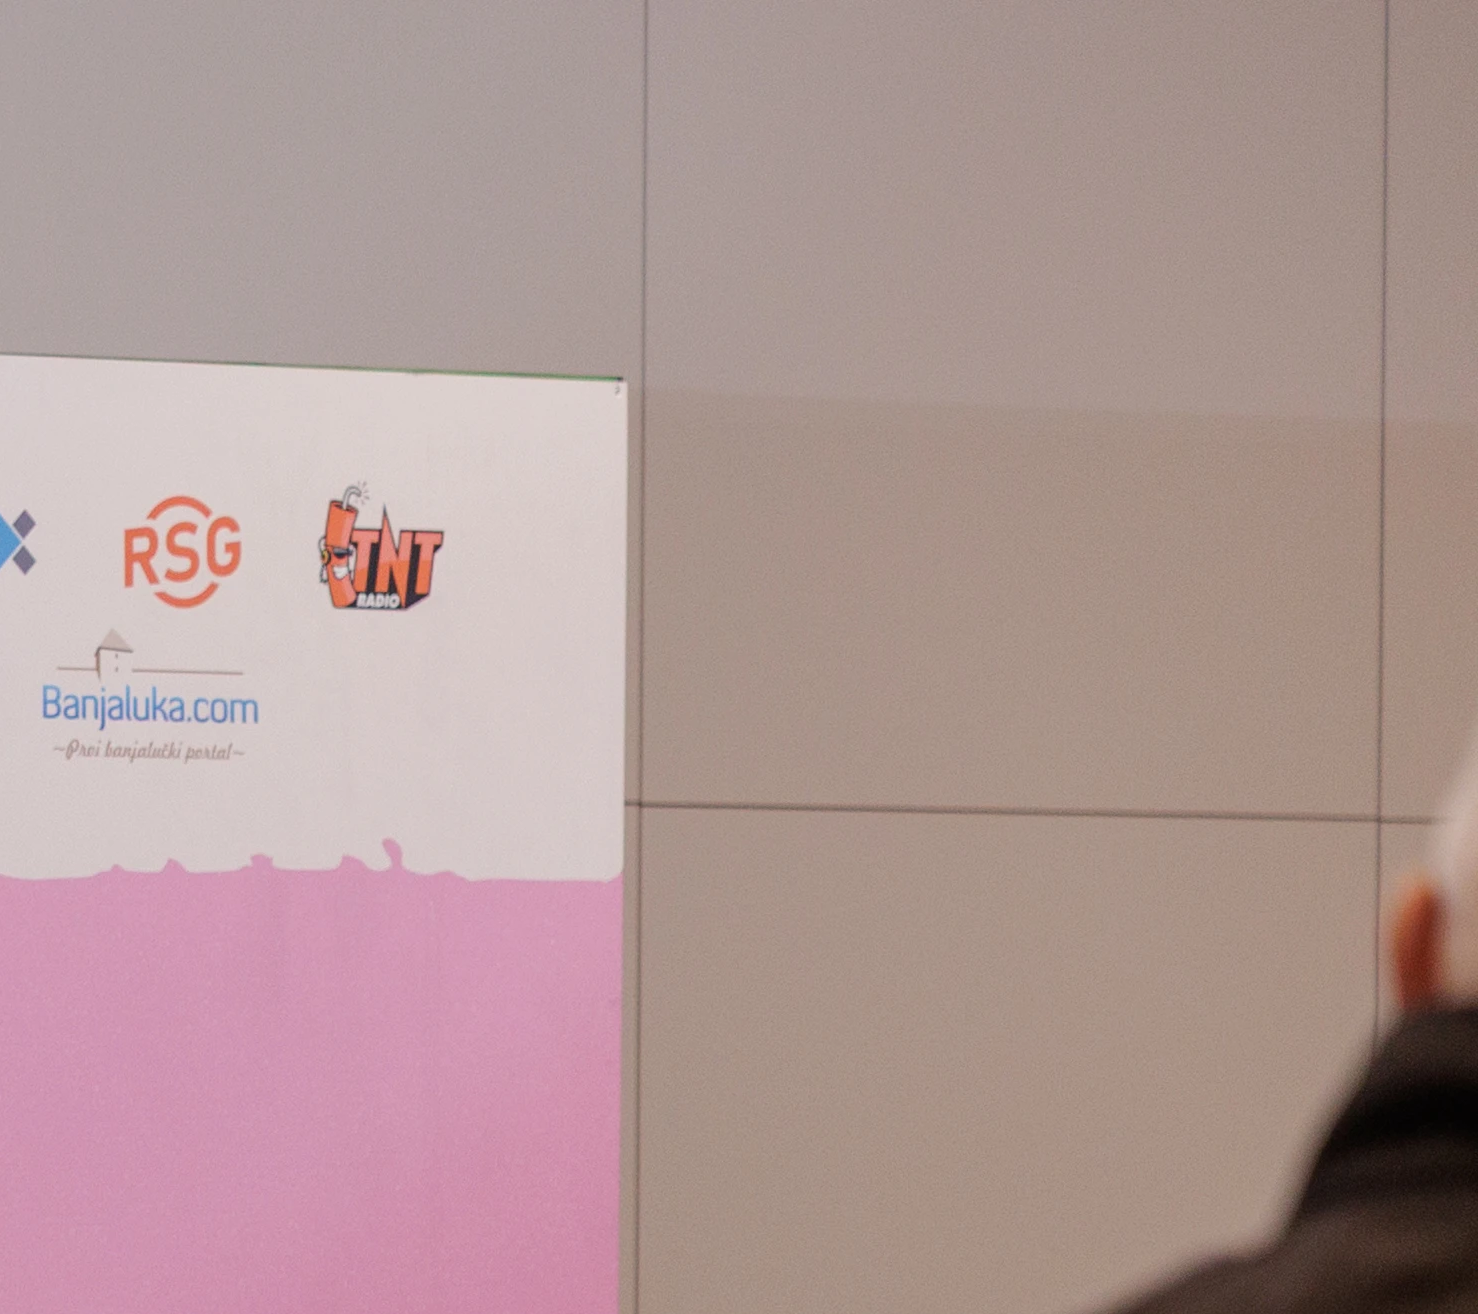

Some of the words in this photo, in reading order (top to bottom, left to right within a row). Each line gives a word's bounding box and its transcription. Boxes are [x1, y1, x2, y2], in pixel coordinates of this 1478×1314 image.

[123, 515, 242, 588] RSG
[351, 503, 444, 596] TNT
[356, 592, 401, 609] RADIO
[42, 684, 259, 731] Banjaluka.com
